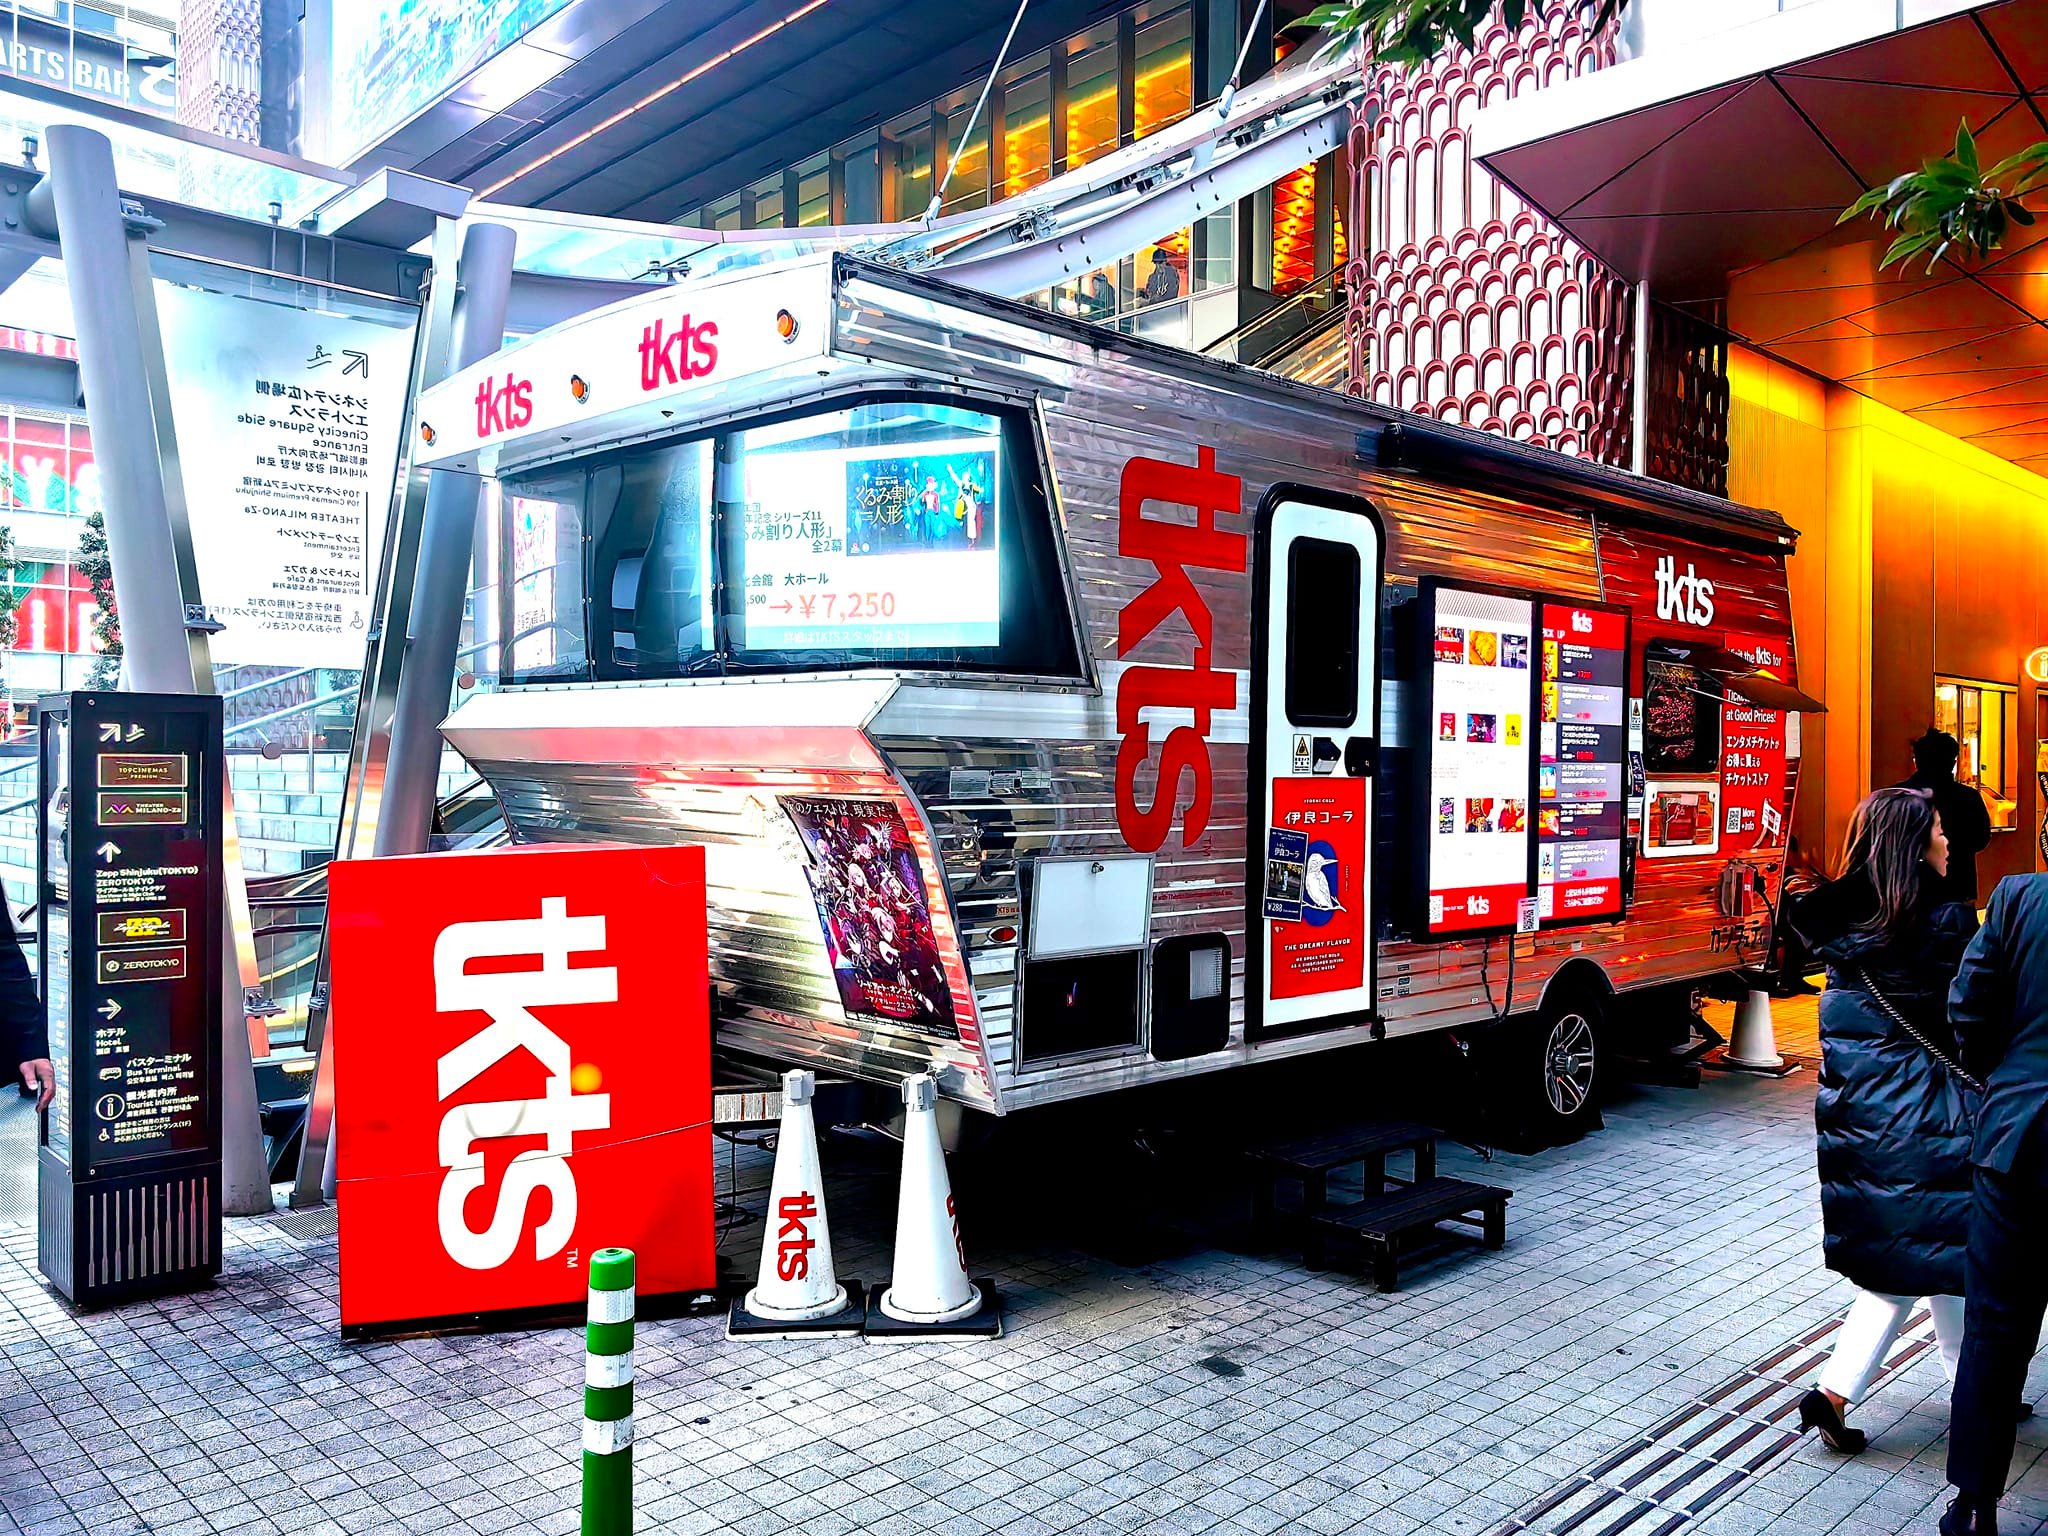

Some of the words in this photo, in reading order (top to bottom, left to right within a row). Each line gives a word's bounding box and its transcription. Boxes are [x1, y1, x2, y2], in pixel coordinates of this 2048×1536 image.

[638, 313, 719, 392] tkts
[475, 372, 533, 439] tkts
[784, 573, 829, 586] 大ホール
[1655, 555, 1715, 627] tkts
[1571, 610, 1593, 633] tkts
[1115, 444, 1249, 853] tkts
[1755, 646, 1772, 665] tkts
[1772, 653, 1782, 666] for
[1726, 709, 1733, 721] at
[1734, 709, 1753, 722] Good
[1754, 709, 1777, 723] Prices!
[1725, 772, 1769, 786] チケットストア
[1284, 810, 1354, 825] 伊良コーラ
[1742, 807, 1756, 818] More
[95, 877, 155, 888] ZEROTOKYO
[1466, 895, 1489, 916] tkts
[1326, 938, 1351, 946] FLAVOR
[122, 958, 180, 970] ZEROTOKYO
[95, 1027, 127, 1039] ホテル
[95, 1038, 122, 1047] Hotel
[126, 1053, 192, 1068] バスターミナル
[126, 1068, 143, 1077] Bus
[144, 1064, 182, 1075] Terminal
[432, 896, 619, 1271] tkts
[126, 1100, 154, 1110] Tourist
[155, 1095, 199, 1106] Information
[776, 1190, 818, 1282] tkts
[566, 1247, 579, 1269] TM
